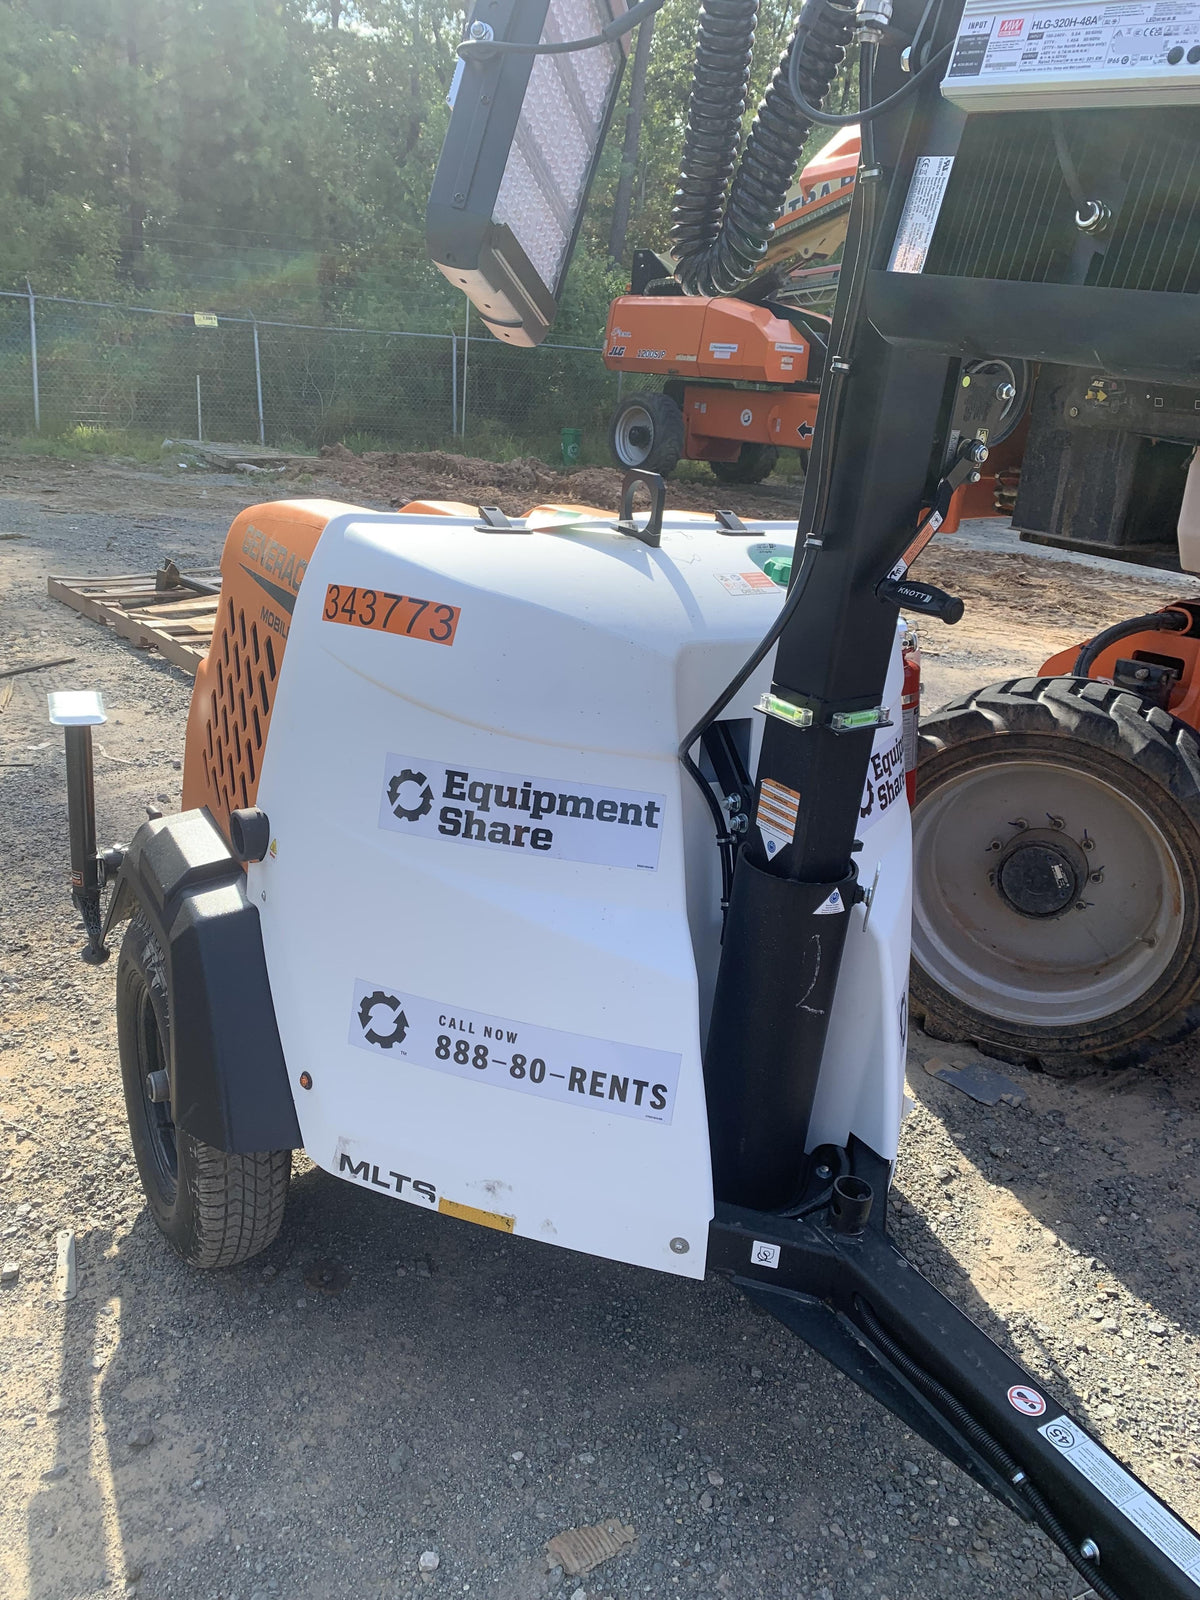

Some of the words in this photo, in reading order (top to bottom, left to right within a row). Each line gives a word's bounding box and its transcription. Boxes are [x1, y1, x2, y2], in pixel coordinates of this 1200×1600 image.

[968, 20, 988, 30] INPUT
[1032, 16, 1098, 30] HLG-320H-48A
[608, 346, 626, 356] JLG
[242, 524, 308, 591] GENERAC
[897, 586, 925, 600] KNOTT
[325, 584, 455, 641] 343773
[442, 769, 660, 829] Equipment
[438, 806, 553, 851] Share
[438, 1014, 475, 1035] CALL
[484, 1025, 518, 1045] NOW
[339, 1153, 437, 1203] MLTS
[1049, 1428, 1070, 1444] 45
